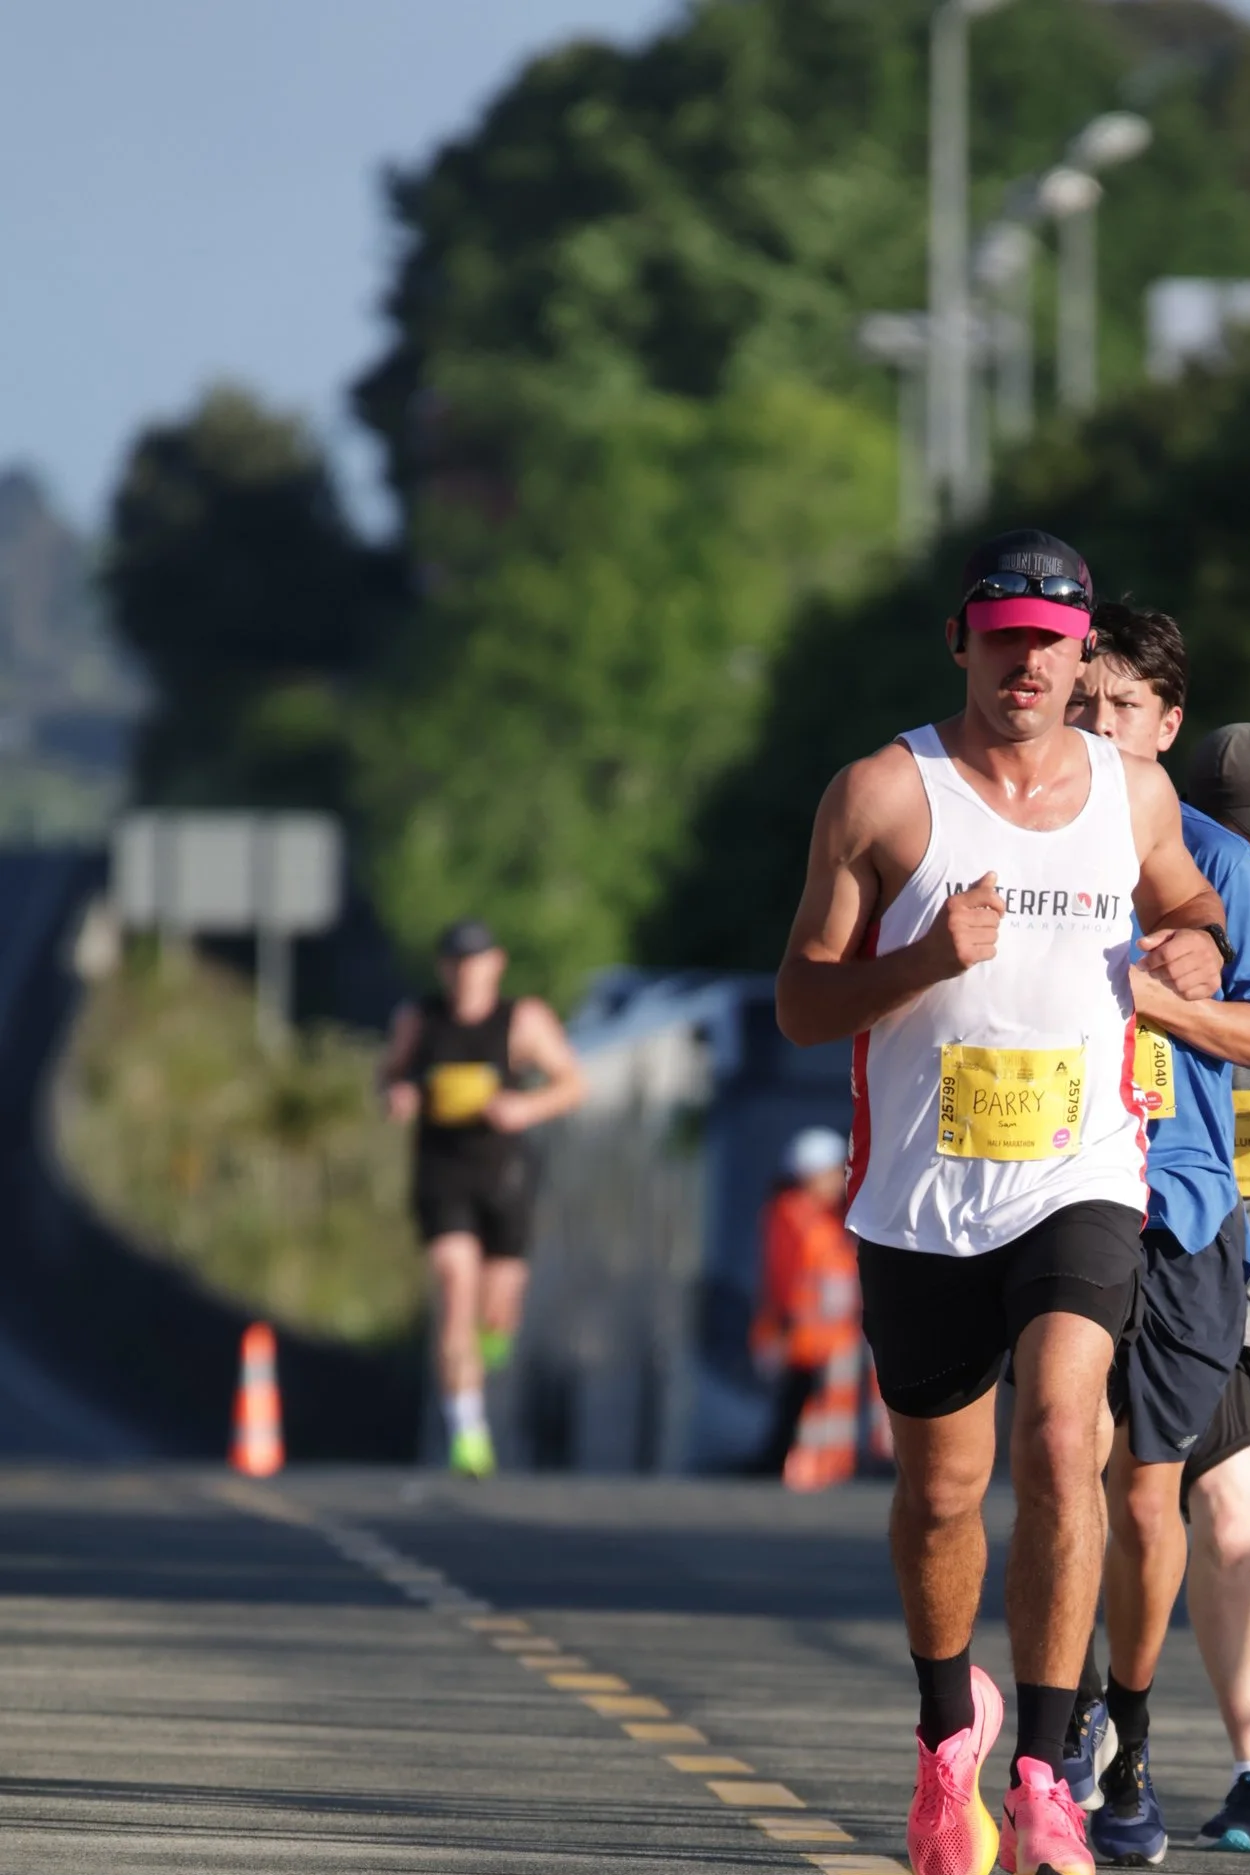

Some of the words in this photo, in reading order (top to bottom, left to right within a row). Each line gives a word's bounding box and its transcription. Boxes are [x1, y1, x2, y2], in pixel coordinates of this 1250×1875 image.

[1153, 1041, 1168, 1087] 24040
[941, 1076, 956, 1123] 25799
[972, 1088, 1046, 1117] BARRY
[1066, 1078, 1081, 1123] 25799
